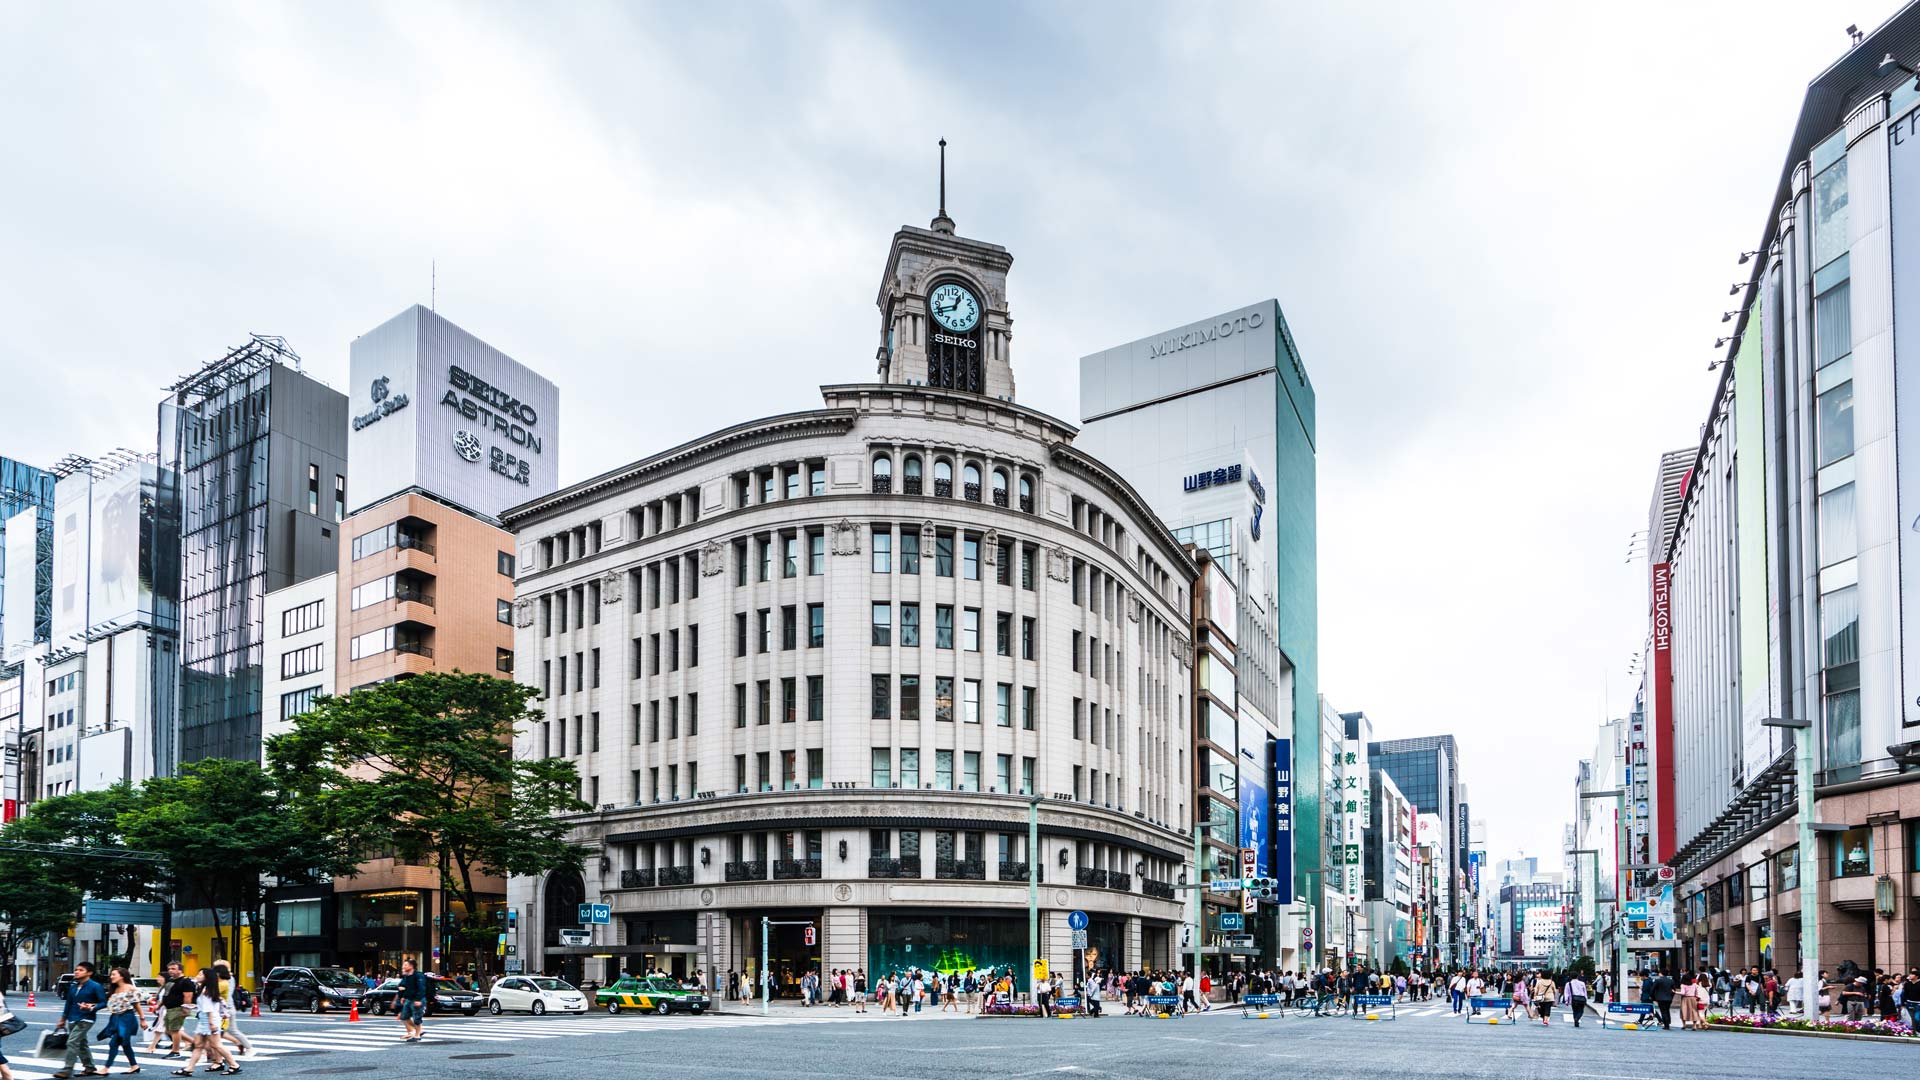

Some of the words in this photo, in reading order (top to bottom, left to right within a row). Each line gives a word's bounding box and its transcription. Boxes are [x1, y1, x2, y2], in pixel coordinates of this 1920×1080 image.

[935, 301, 940, 309] 9
[935, 334, 976, 348] SEIKO
[1150, 312, 1264, 360] MIKIMOTO
[449, 365, 537, 426] SEIKO
[440, 389, 541, 454] ASTRON
[489, 462, 530, 486] SOLAR
[490, 445, 530, 475] GPS
[1183, 463, 1242, 492] 山野楽器
[1655, 569, 1669, 650] MITSUKOSHI
[1277, 770, 1289, 831] 山野楽器
[1345, 751, 1357, 813] 教文館
